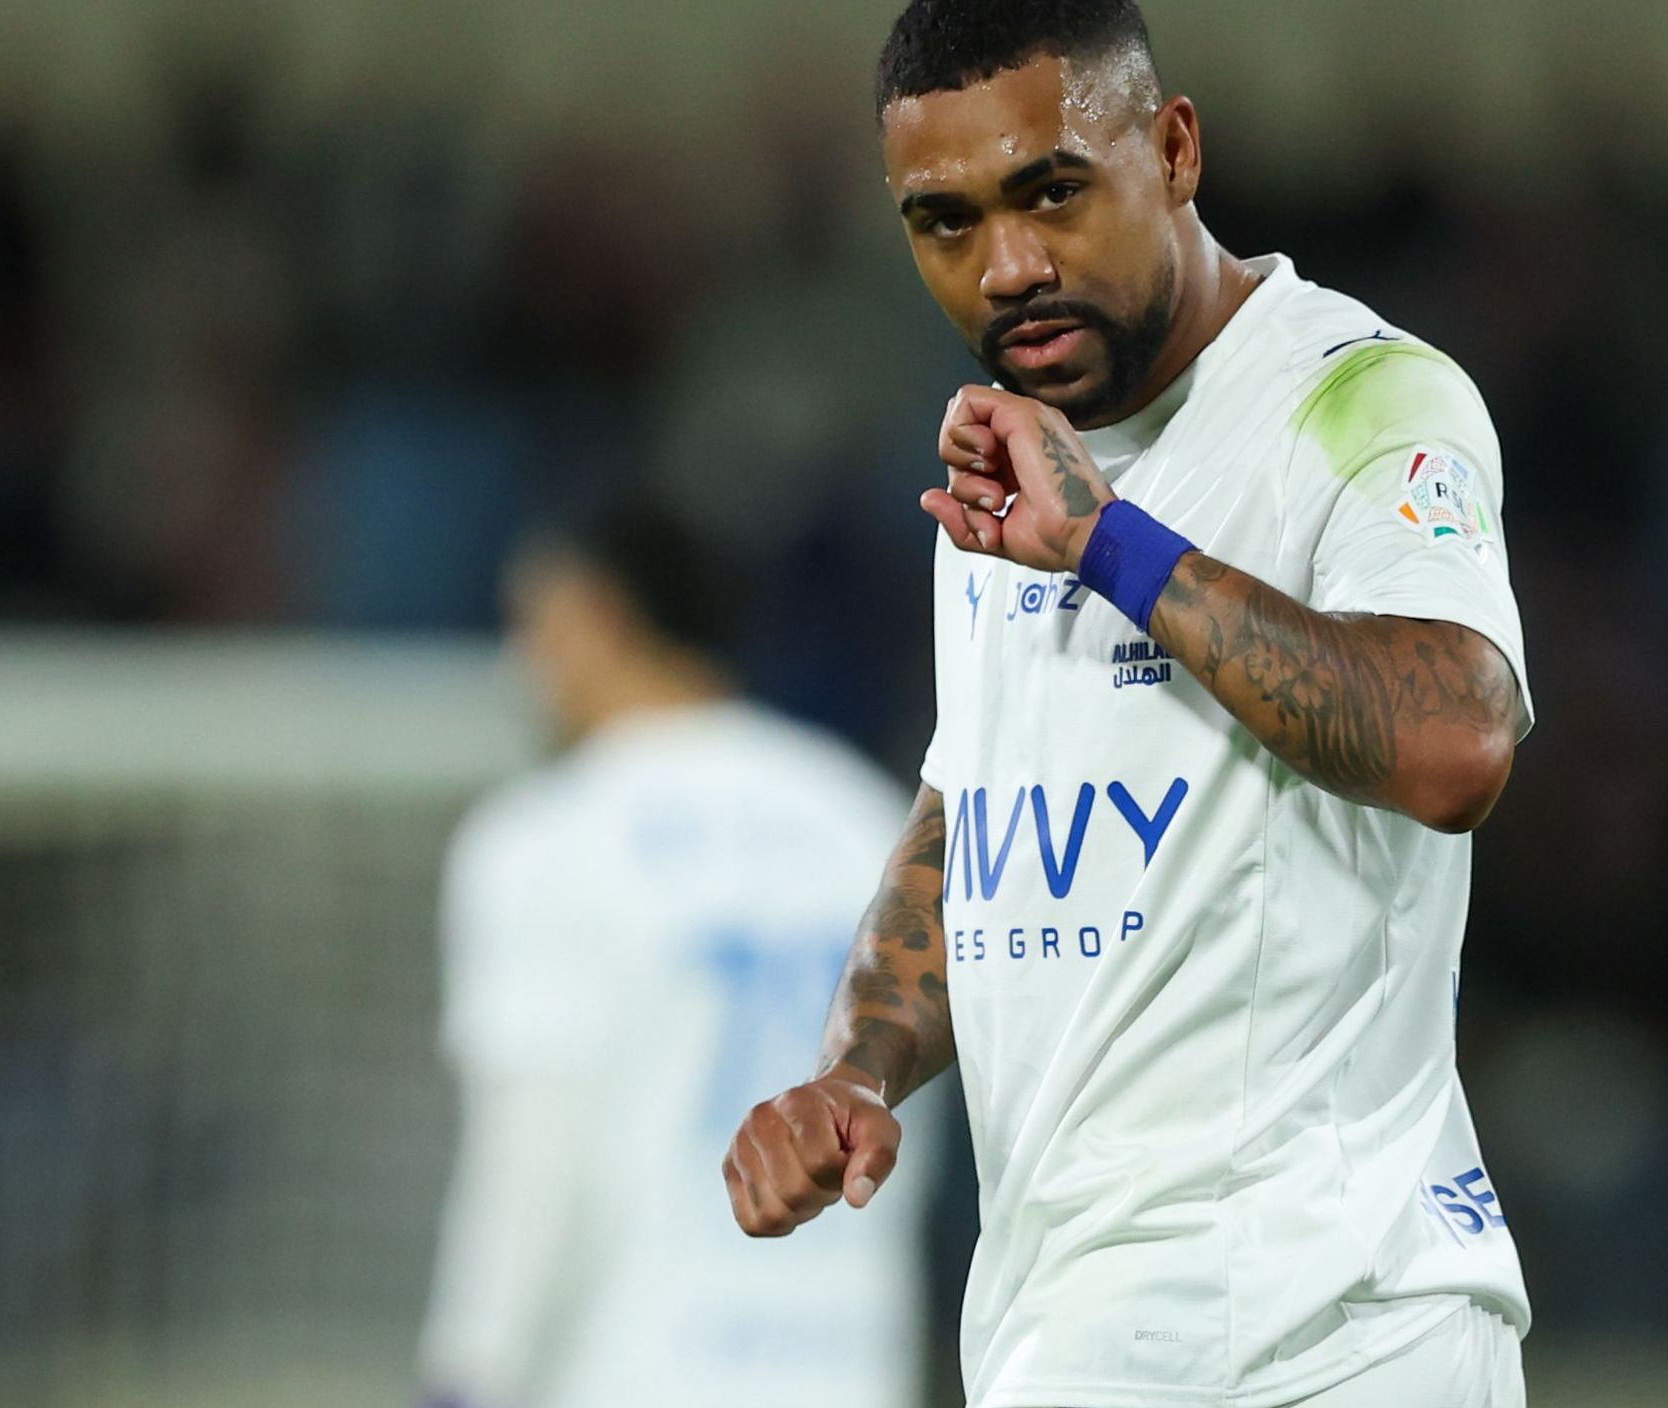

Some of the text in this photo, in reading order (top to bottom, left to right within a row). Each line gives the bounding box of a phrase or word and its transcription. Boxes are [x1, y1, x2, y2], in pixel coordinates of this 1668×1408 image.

[943, 776, 1190, 904] AVVY
[1008, 910, 1144, 959] GROP
[1134, 1329, 1183, 1343] DRYCELL
